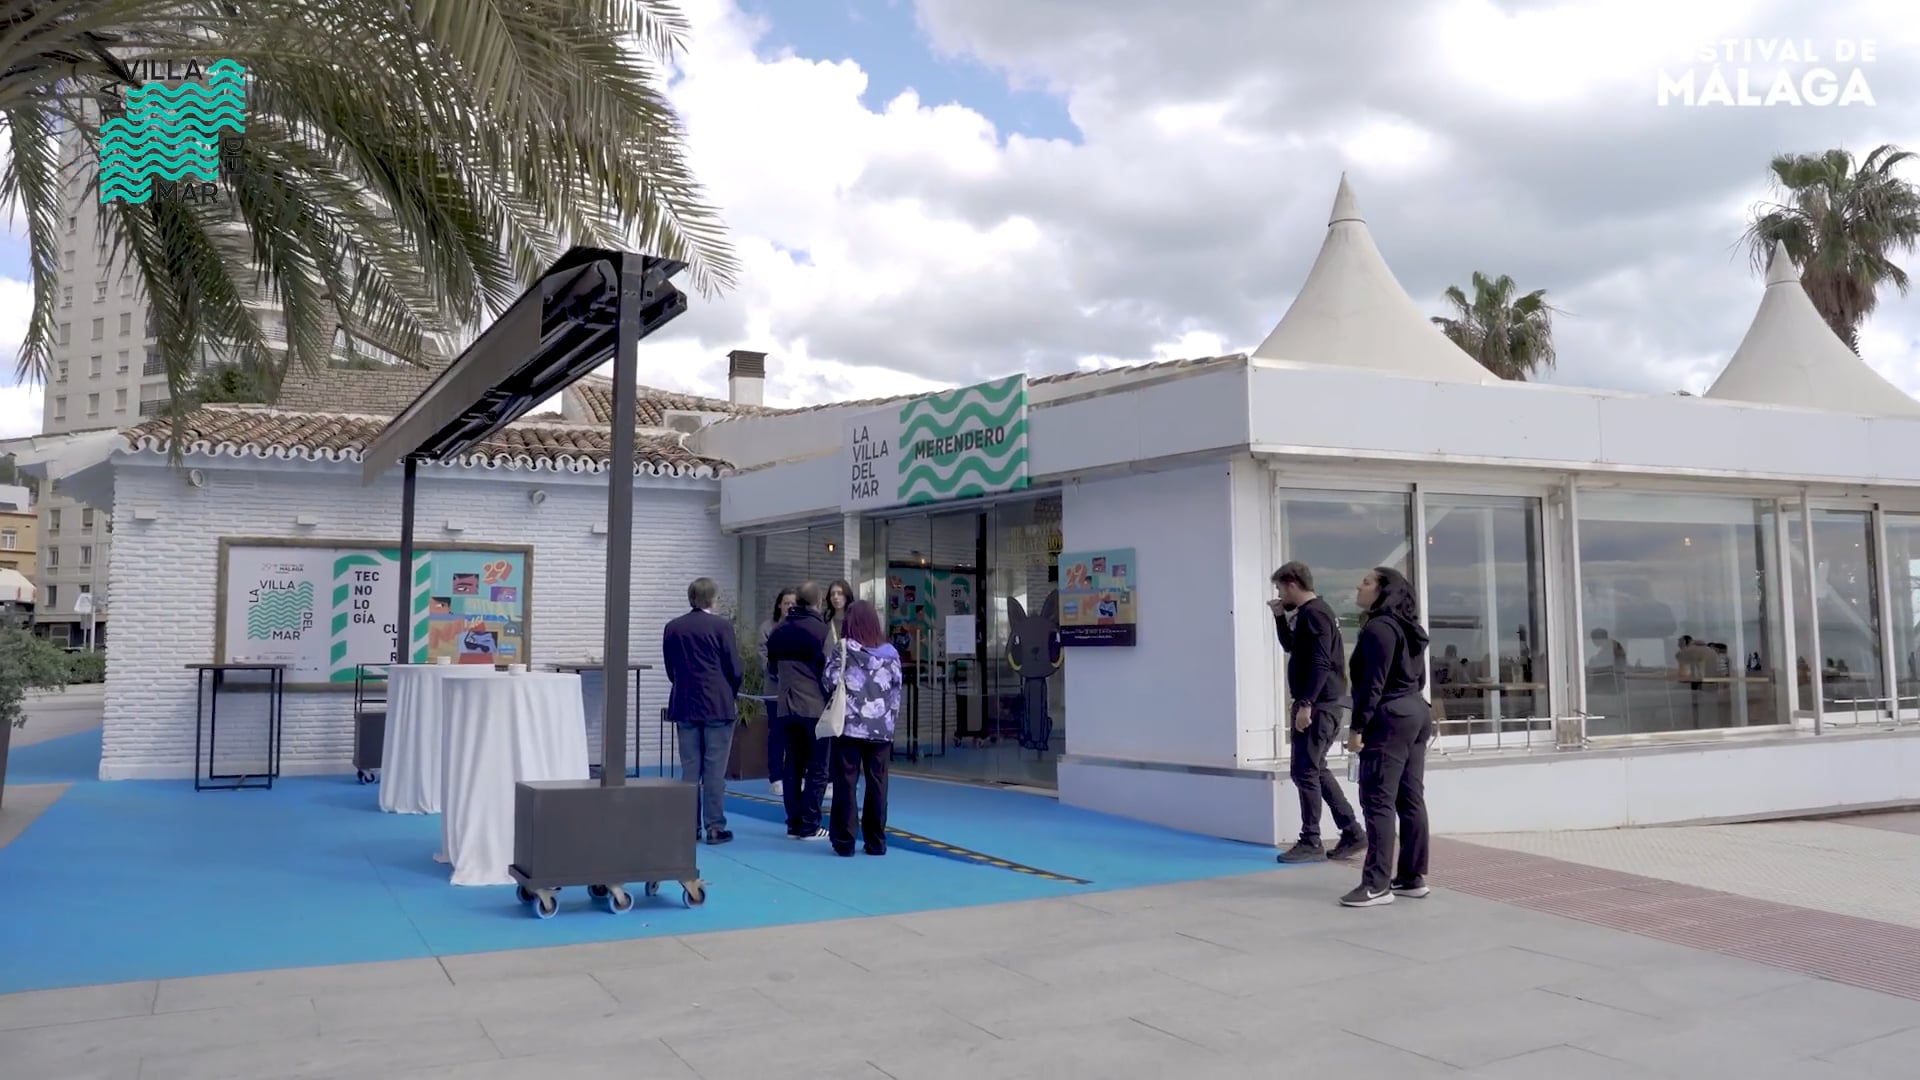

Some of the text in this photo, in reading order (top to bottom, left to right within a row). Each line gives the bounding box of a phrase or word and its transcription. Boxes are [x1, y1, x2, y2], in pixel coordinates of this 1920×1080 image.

[853, 425, 869, 444] LA
[914, 426, 1005, 460] MERENDERO
[852, 440, 889, 462] VILLA
[852, 462, 876, 481] DEL
[851, 480, 880, 500] MAR
[354, 571, 380, 582] TEC
[481, 559, 512, 585] 29
[259, 580, 296, 591] VILLA
[354, 586, 373, 596] NO
[249, 588, 259, 603] LA
[353, 600, 370, 610] LO
[302, 611, 313, 632] DEL
[353, 612, 376, 624] GÍA
[272, 631, 301, 640] MAR
[383, 624, 398, 634] CU
